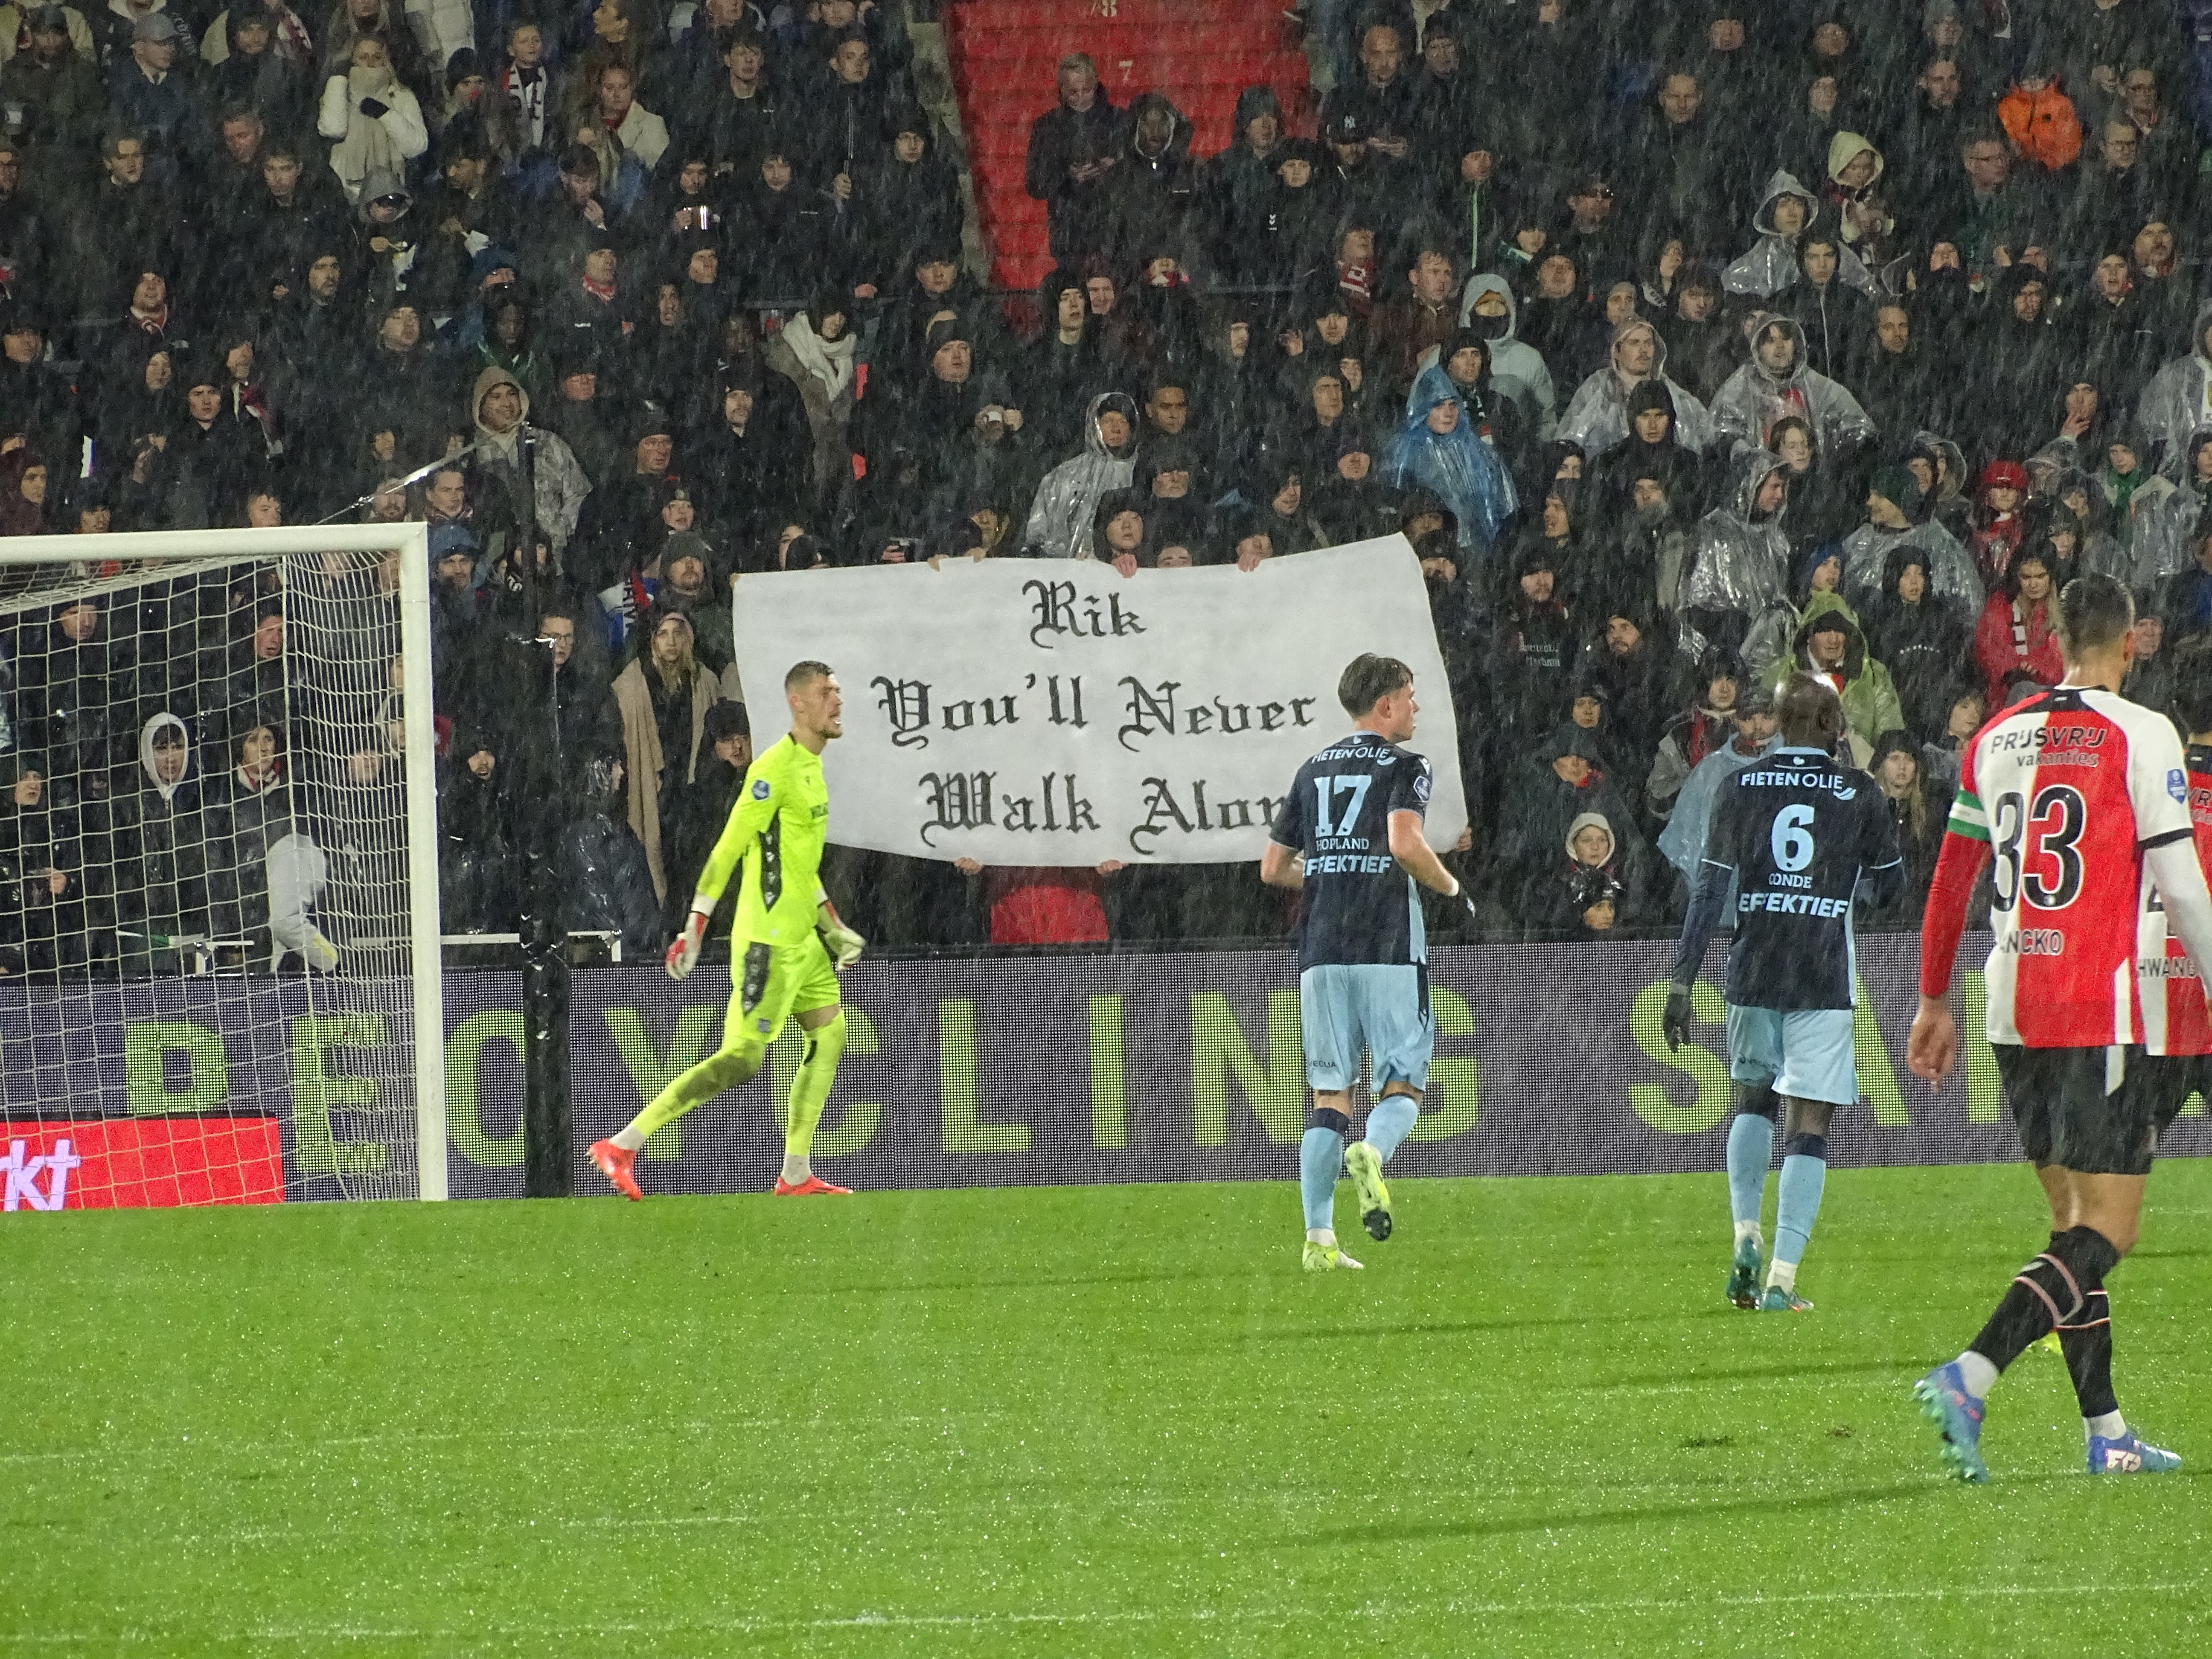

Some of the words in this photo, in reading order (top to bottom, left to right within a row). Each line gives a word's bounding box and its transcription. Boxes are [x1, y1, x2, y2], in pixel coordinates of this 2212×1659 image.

[1118, 60, 1133, 82] 7
[1022, 579, 1147, 649] Rik
[870, 673, 1089, 750] You'll
[1117, 675, 1316, 753] Never
[2017, 749, 2099, 768] vakanties
[918, 770, 1101, 848] Walk
[1129, 777, 1288, 856] Alon
[1313, 774, 1372, 838] 17
[1771, 803, 1815, 872] 6
[1316, 838, 1370, 852] HOPLAND
[1992, 784, 2087, 912] 33
[2000, 929, 2064, 955] NCKO
